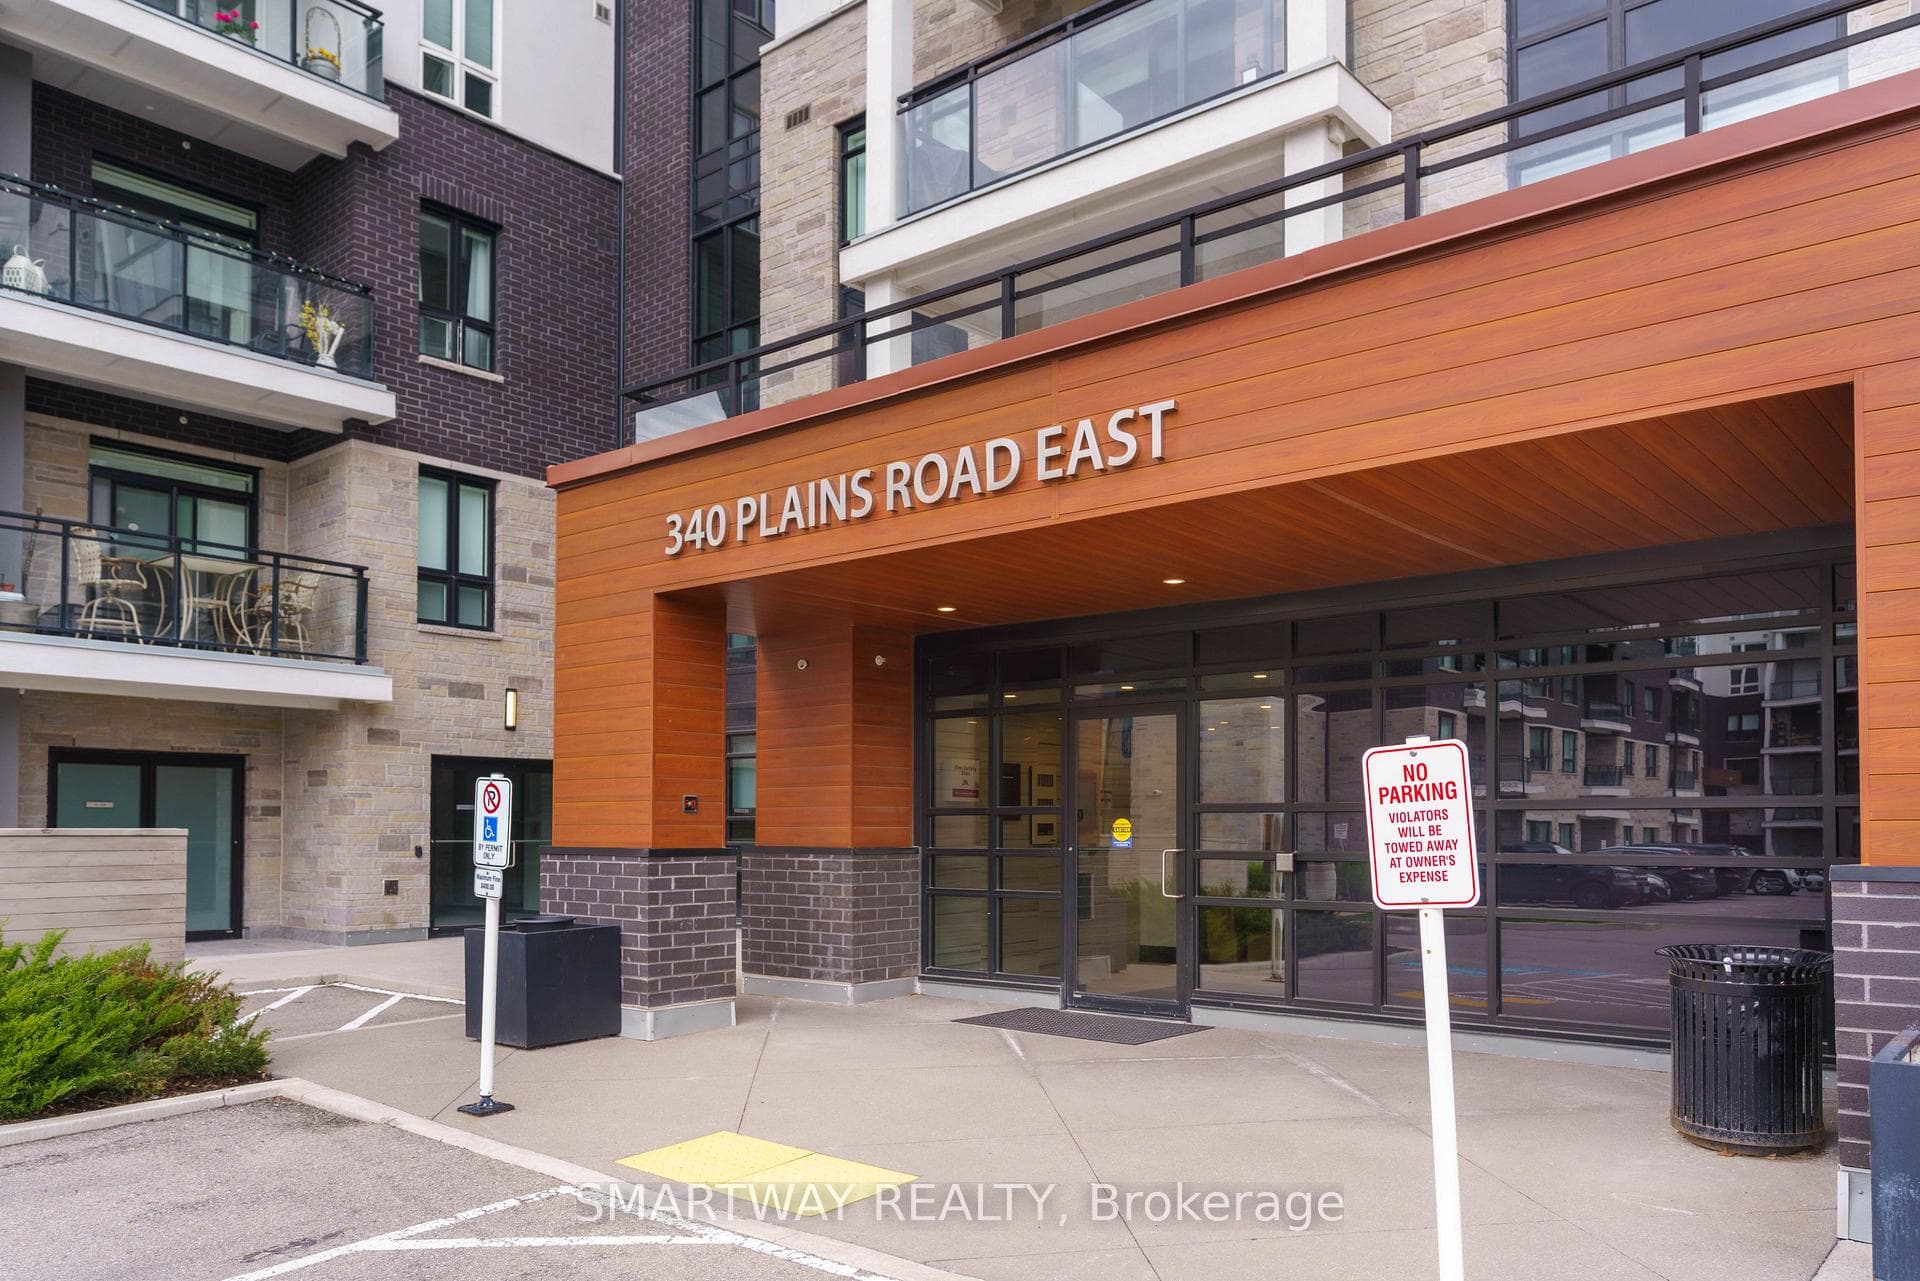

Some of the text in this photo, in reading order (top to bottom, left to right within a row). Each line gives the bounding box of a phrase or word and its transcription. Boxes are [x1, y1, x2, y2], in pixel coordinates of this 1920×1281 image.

[664, 399, 1178, 556] 340 PLAINS ROAD EAST
[1403, 763, 1428, 783] NO
[1379, 781, 1458, 805] PARKING
[1389, 809, 1449, 824] VIOLATORS
[1398, 825, 1442, 838] WILL BE
[478, 843, 503, 853] BY PERMIT
[1384, 839, 1459, 854] TOWED AWAY
[483, 852, 495, 860] ONLY
[1390, 855, 1456, 868] AT OWNER'S
[1400, 871, 1449, 883] EXPENSE
